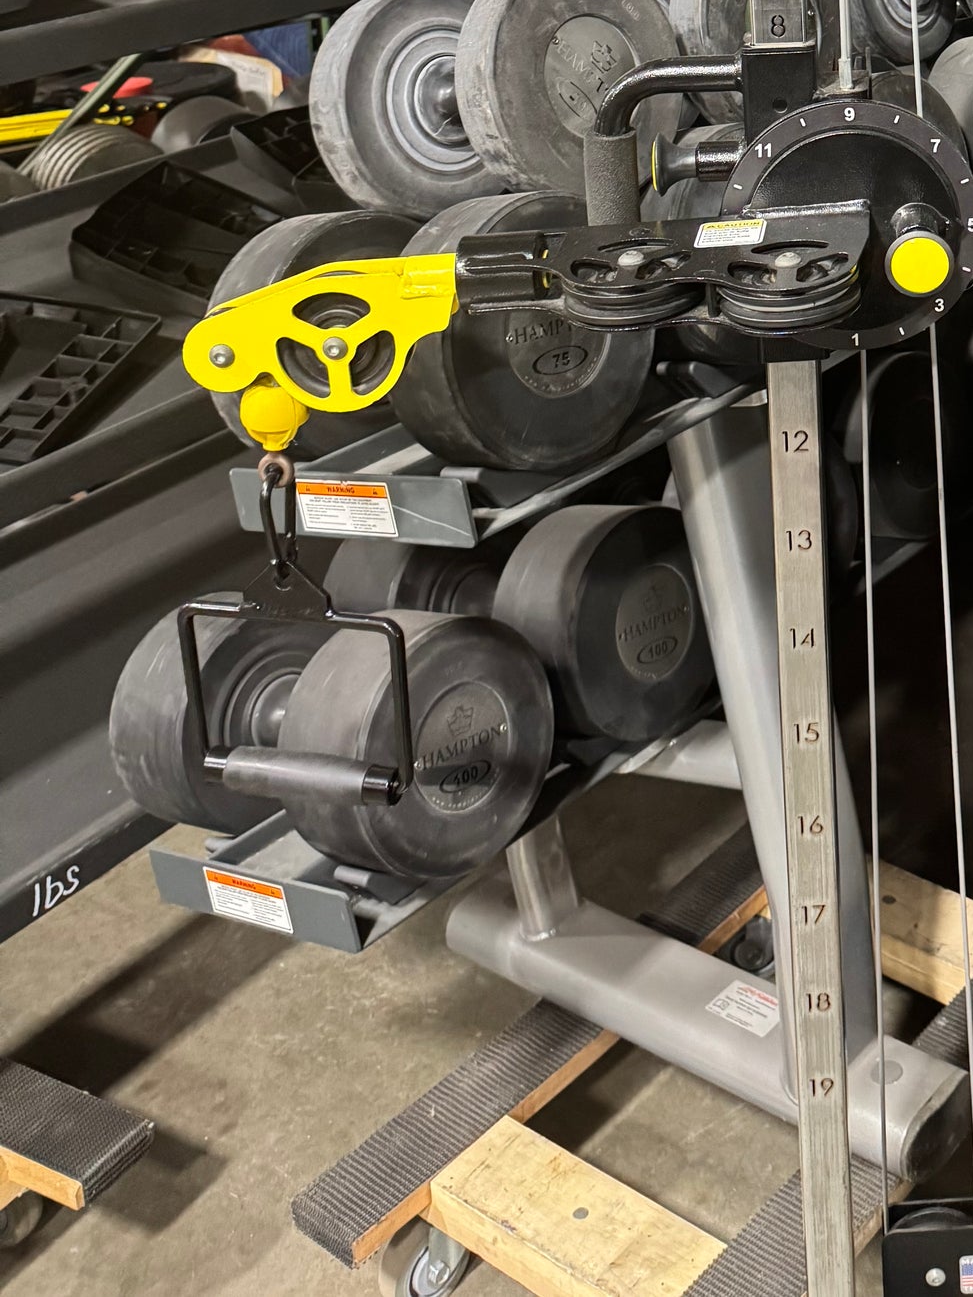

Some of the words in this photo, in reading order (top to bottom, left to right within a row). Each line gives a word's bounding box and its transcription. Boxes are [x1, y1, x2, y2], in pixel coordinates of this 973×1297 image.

[771, 14, 786, 38] 8
[844, 108, 856, 122] 9
[754, 143, 773, 158] 11
[930, 138, 942, 152] 7
[934, 299, 945, 312] 3
[851, 332, 860, 346] 1
[552, 351, 571, 369] 75
[781, 430, 810, 453] 12
[785, 529, 812, 551] 13
[789, 627, 815, 649] 14
[792, 722, 820, 744] 15
[422, 722, 501, 771] HAMPTON
[797, 815, 824, 835] 16
[32, 865, 80, 916] lbs
[801, 904, 826, 926] 17
[805, 992, 831, 1014] 18
[808, 1078, 834, 1098] 19
